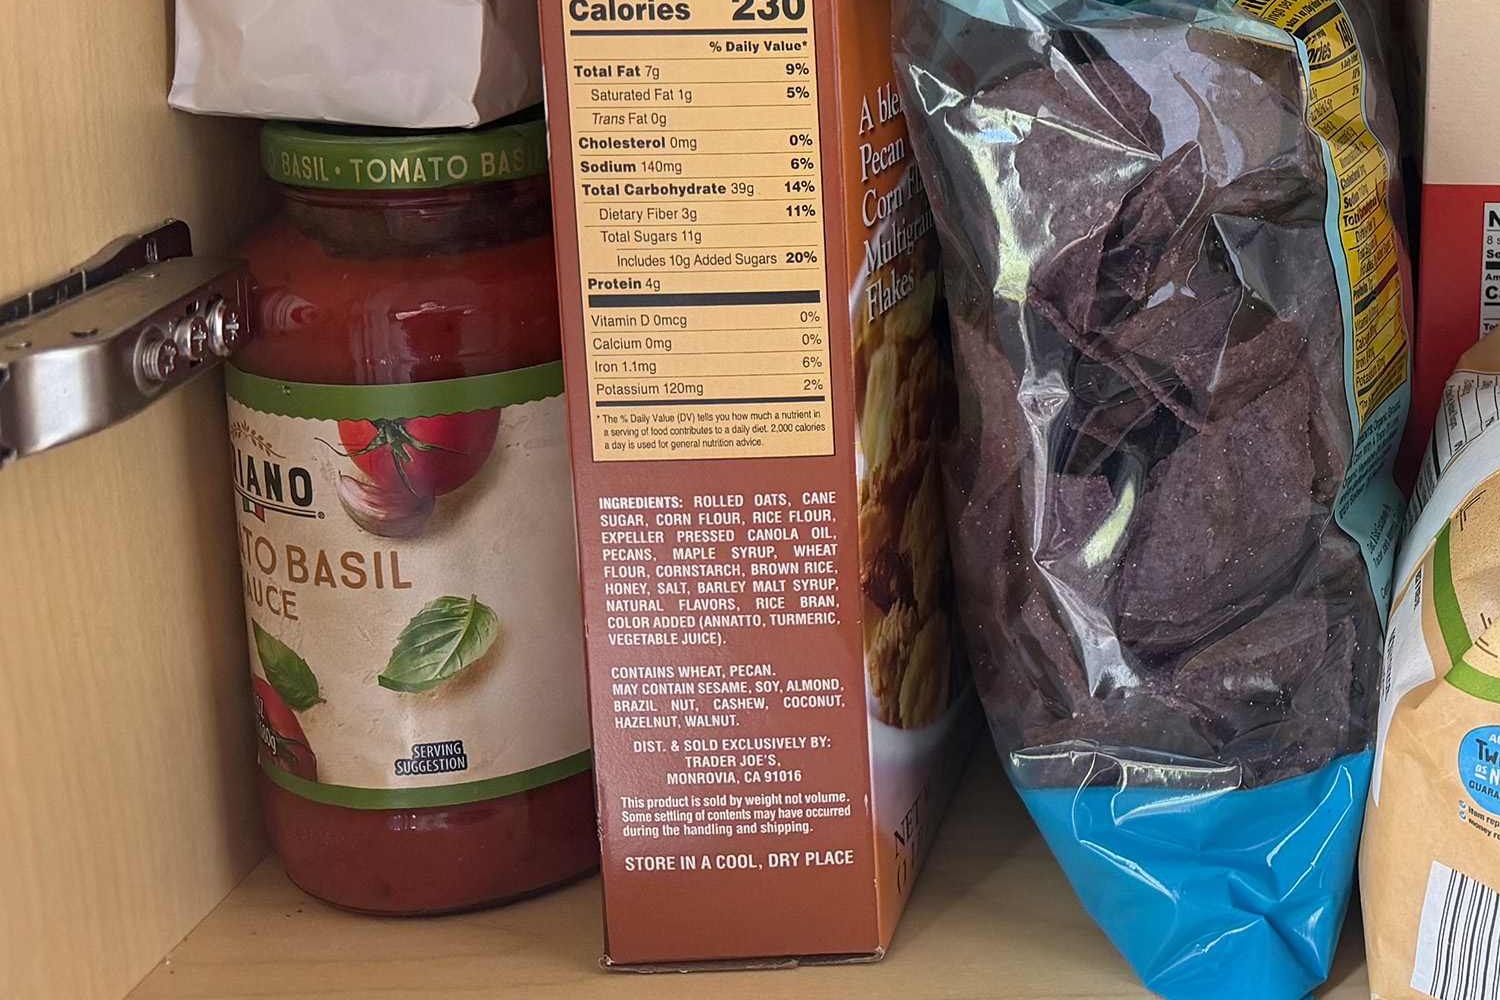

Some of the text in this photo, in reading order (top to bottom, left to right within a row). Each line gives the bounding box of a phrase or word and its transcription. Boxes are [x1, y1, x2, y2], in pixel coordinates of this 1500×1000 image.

[725, 41, 760, 54] Daily
[574, 62, 810, 80] Total Fat 7g 9%
[578, 134, 813, 151] Cholesterol 0mg 0%
[281, 151, 468, 184] BASIL TOMATO
[580, 157, 814, 174] Sodium 140mg 6%
[860, 137, 904, 184] Pecan
[582, 181, 815, 197] Total Carbohydrate 39g 14%
[862, 179, 904, 228] Corn
[588, 278, 661, 291] Protein 4g
[867, 268, 915, 324] Flakes
[594, 356, 822, 374] Iron 1.1mg 6%
[599, 491, 836, 510] INGREDIENTS: ROLLED OATS, CANE
[285, 544, 412, 590] BASIL
[412, 742, 462, 758] SERVING
[395, 755, 468, 774] SUGGESTION
[1468, 806, 1489, 823] item
[1468, 817, 1493, 839] money
[625, 849, 855, 871] STORE IN A COOL, DRY PLACE
